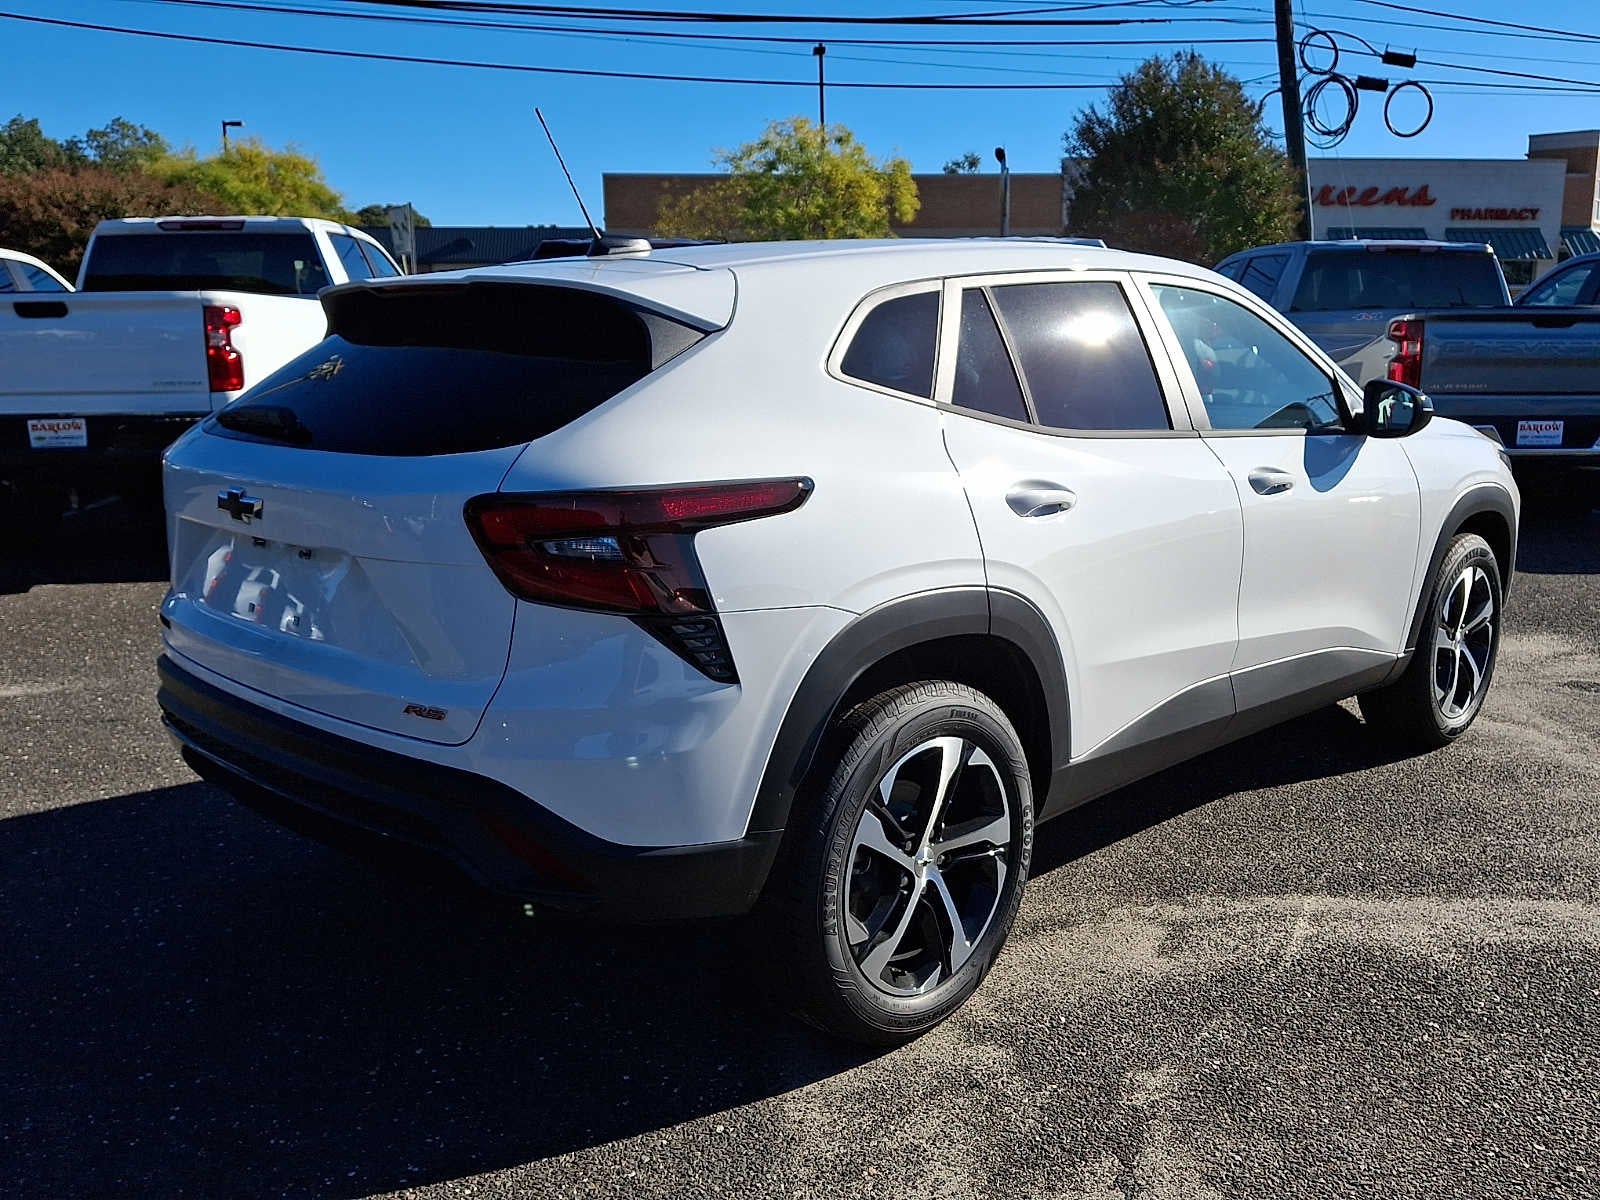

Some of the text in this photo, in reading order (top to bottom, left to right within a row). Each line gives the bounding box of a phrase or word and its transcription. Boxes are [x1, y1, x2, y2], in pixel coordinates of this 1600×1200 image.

[1311, 184, 1438, 206] reens
[1451, 208, 1540, 220] PHARMACY
[31, 422, 82, 433] BARLOW
[1519, 423, 1562, 434] BARLOW
[403, 702, 447, 720] RS
[823, 790, 862, 936] ASSURANCE
